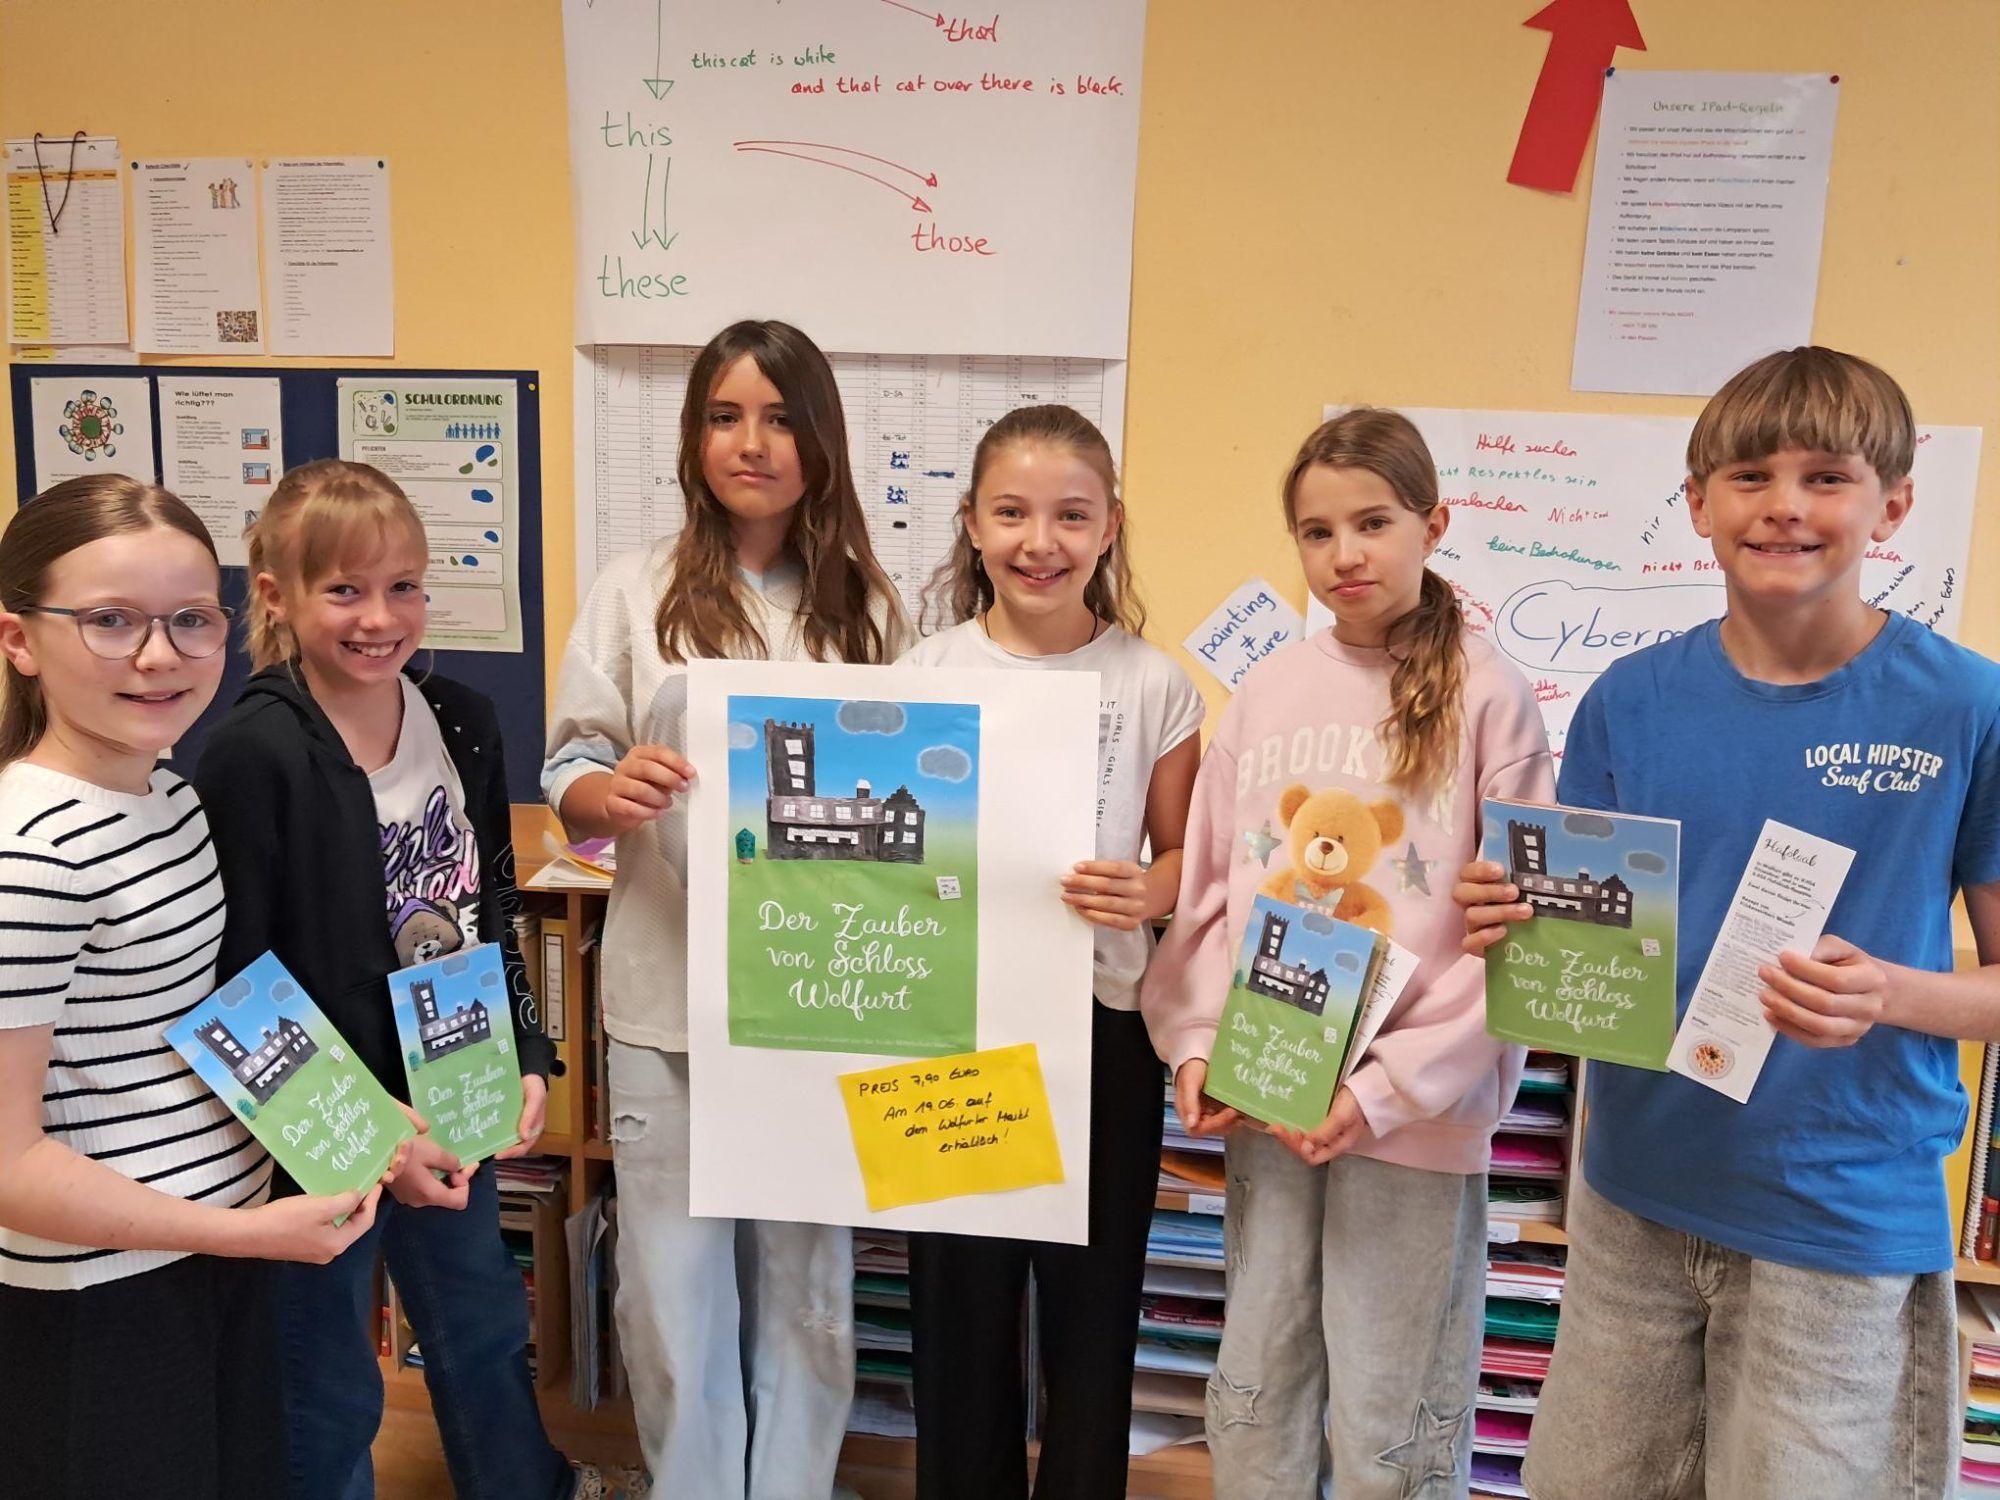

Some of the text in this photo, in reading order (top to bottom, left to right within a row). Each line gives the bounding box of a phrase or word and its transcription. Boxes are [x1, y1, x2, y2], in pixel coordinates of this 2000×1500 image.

[944, 15, 999, 43] that
[692, 50, 726, 68] this
[770, 51, 785, 66] is
[792, 47, 836, 66] white
[791, 79, 825, 95] and
[837, 76, 881, 94] that
[896, 78, 926, 93] cat
[934, 80, 973, 93] over
[981, 75, 1033, 93] there
[1050, 76, 1066, 95] is
[1652, 100, 1695, 112] Unsere
[600, 111, 673, 148] this
[912, 222, 997, 256] those
[598, 254, 690, 299] these
[175, 390, 190, 398] Wie
[175, 398, 216, 409] richtig???
[405, 392, 503, 406] SCHULORDNUNG
[1477, 433, 1577, 458] Hilfe suchen
[1486, 535, 1525, 556] keine
[1198, 591, 1277, 662] painting
[1511, 592, 1685, 662] Cyberm
[1111, 713, 1124, 744] GIRLS
[1102, 755, 1116, 786] GIRLS
[1805, 743, 1944, 779] LOCAL HIPSTER
[1821, 766, 1922, 794] Surf Club
[758, 900, 946, 941] Der Zauber
[766, 940, 933, 979] von Schloss
[1505, 942, 1648, 982] Der Zauber
[788, 979, 912, 1022] Wolfurt
[1509, 974, 1637, 1010] von Schloss
[1526, 999, 1620, 1034] Wolfurt
[1232, 1012, 1323, 1063] Der Zauber
[859, 1067, 980, 1097] PREIS 7,90 EURO
[1234, 1063, 1295, 1101] Wolfurt
[1256, 1047, 1307, 1085] Schloss
[428, 1065, 507, 1106] Der Zauber
[282, 1074, 356, 1147] Der Zauber
[883, 1106, 908, 1122] Am
[966, 1092, 993, 1109] auf
[306, 1098, 370, 1160] von Schloss
[332, 1119, 379, 1171] Wolfurt
